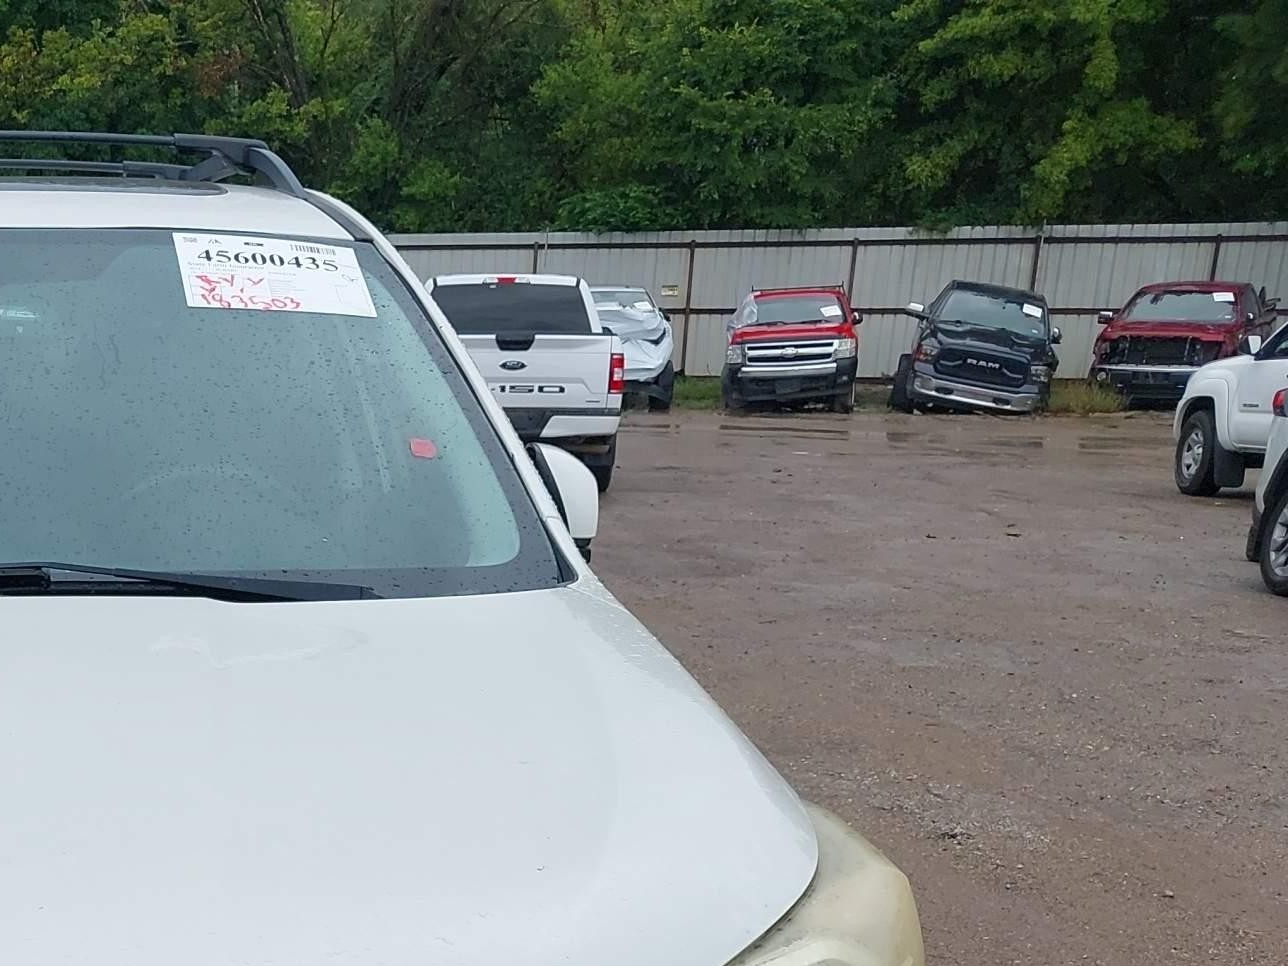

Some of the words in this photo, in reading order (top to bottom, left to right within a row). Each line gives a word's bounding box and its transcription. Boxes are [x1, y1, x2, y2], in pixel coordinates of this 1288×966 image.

[197, 249, 339, 272] 45600435
[966, 358, 1001, 369] RAM
[490, 385, 565, 393] -150
